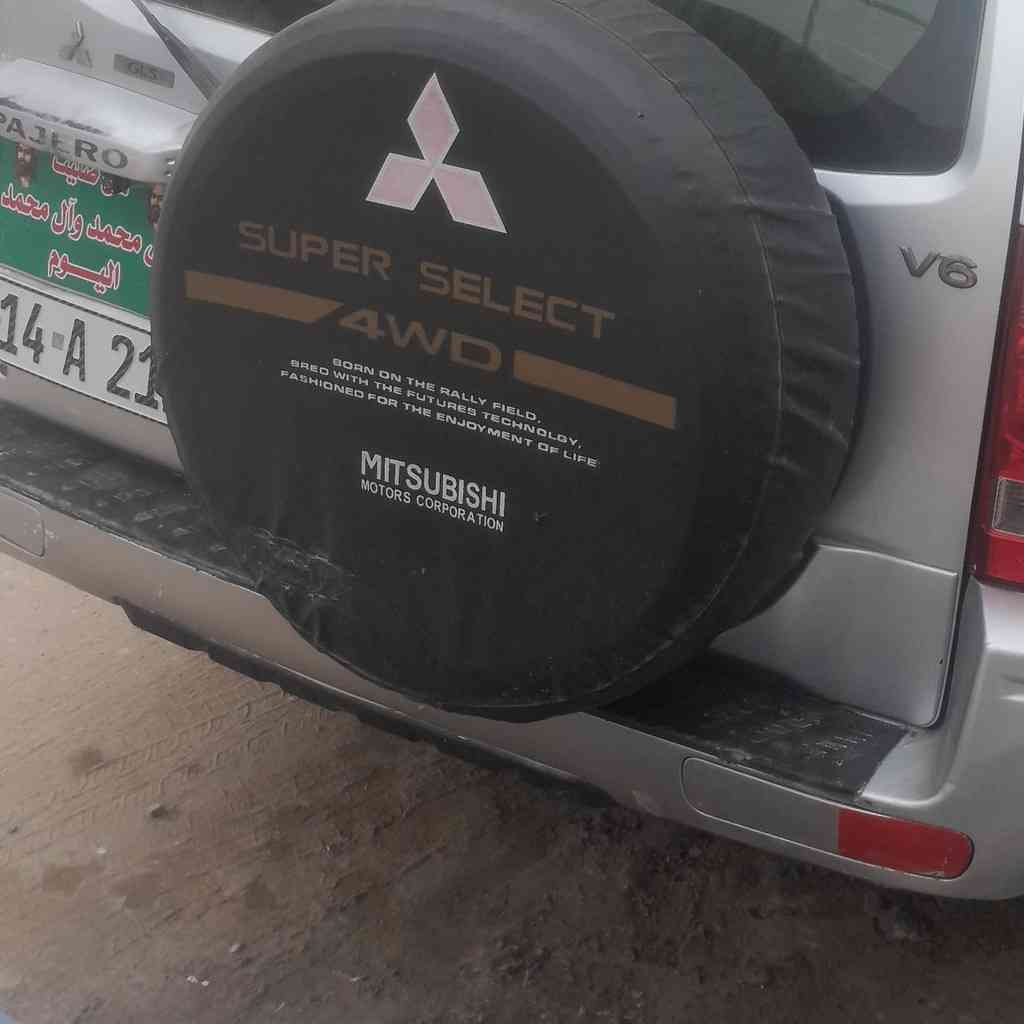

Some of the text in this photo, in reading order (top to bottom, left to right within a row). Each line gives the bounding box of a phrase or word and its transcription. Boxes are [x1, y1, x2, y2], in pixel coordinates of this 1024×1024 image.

[0, 182, 50, 222] محمد
[87, 215, 143, 254] محمد
[238, 220, 616, 340] SUPER SELECT
[898, 245, 979, 289] V6
[62, 318, 86, 382] A
[337, 308, 502, 373] 4WD
[290, 359, 329, 376] BRED
[333, 369, 369, 387] WITH
[373, 380, 403, 395] THE
[406, 389, 477, 416] FUTURES
[332, 357, 375, 376] BORN
[378, 369, 402, 383] ON
[405, 376, 436, 392] THE
[440, 386, 487, 406] RALLY
[280, 370, 365, 399] FASHIONED
[367, 392, 399, 408] FOR
[402, 401, 433, 418] THE
[436, 412, 534, 448] ENJOYMENT
[537, 441, 560, 454] OF
[360, 449, 506, 518] MITSUBISHI
[360, 478, 505, 533] MOTORS CORPORATION
